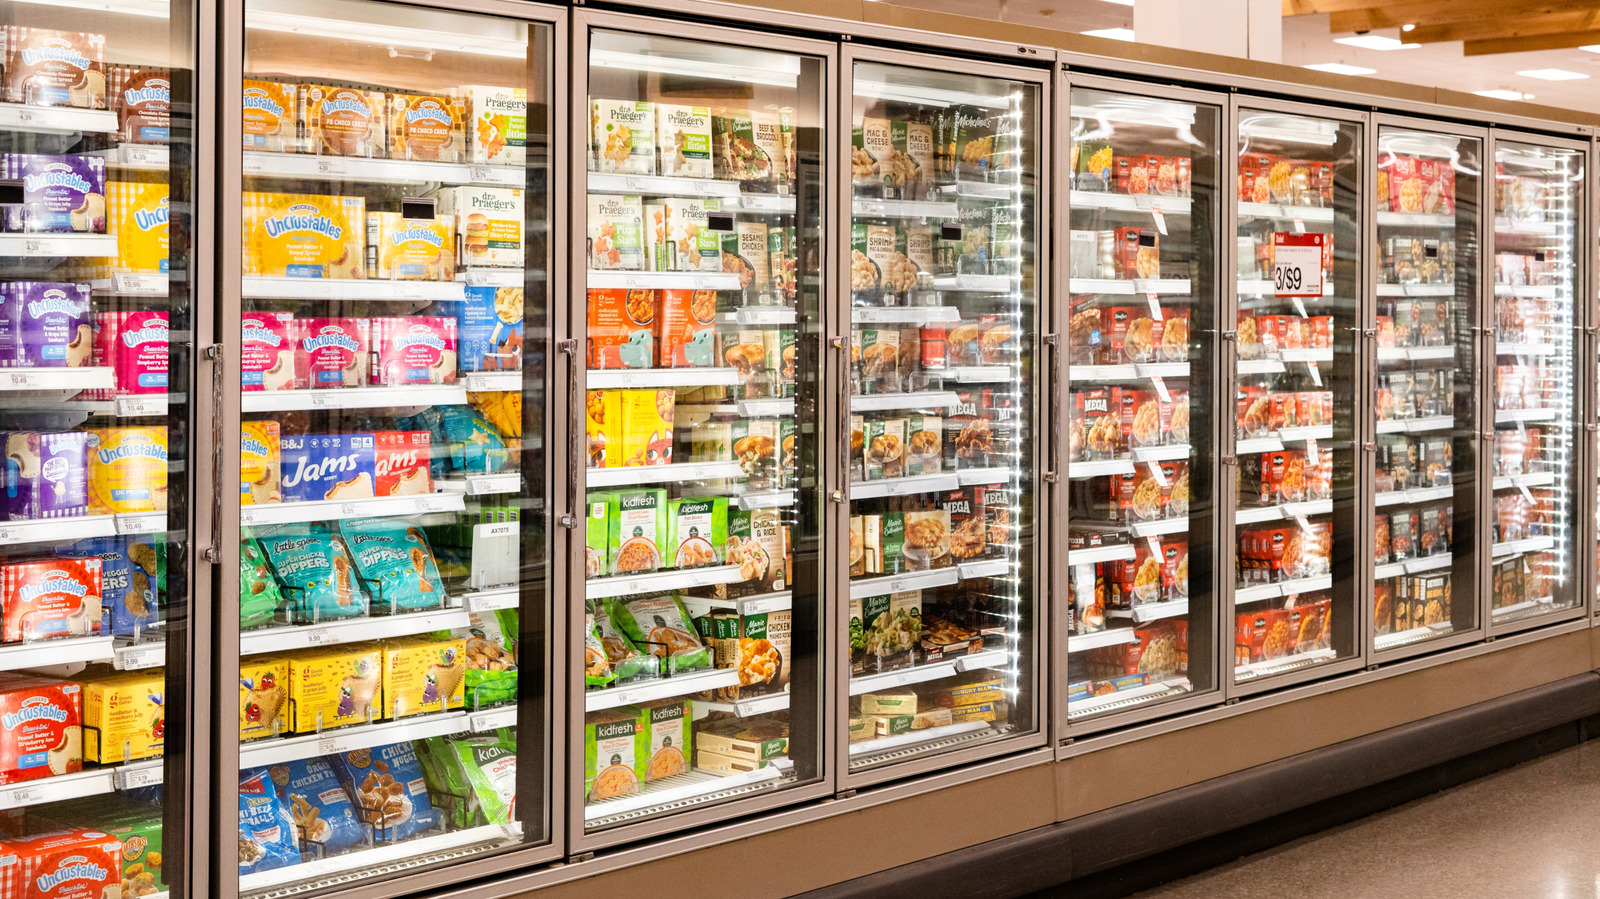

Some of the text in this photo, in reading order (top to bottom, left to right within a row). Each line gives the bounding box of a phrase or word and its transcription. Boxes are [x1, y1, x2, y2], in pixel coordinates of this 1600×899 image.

[22, 48, 90, 70] Uncrustables
[322, 100, 371, 118] Uncrustables
[486, 97, 526, 111] Praeger's
[406, 108, 452, 125] Uncrustables
[610, 110, 648, 122] Praeger's
[668, 114, 704, 128] Praeger's
[506, 129, 526, 138] littles
[759, 124, 770, 132] BEEF
[866, 128, 880, 138] MAC
[756, 132, 779, 142] BROCCOLI
[866, 136, 888, 146] CHEESE
[910, 134, 930, 144] MAC &
[688, 142, 706, 150] littles
[910, 142, 930, 151] CHEESE
[25, 172, 90, 194] Uncrustables
[472, 197, 516, 212] Praeger's
[598, 204, 636, 216] Praeger's
[264, 214, 342, 239] Uncrustables
[616, 224, 636, 234] Pizza
[392, 228, 442, 246] Uncrustables
[617, 235, 637, 245] Stars
[699, 238, 716, 248] Stars
[742, 234, 764, 242] SESAME
[869, 237, 893, 247] SHRIMP
[742, 242, 764, 250] CHICKEN
[909, 239, 930, 248] SHRIMP
[1276, 266, 1302, 292] 3/$9
[28, 298, 80, 319] Uncrustables
[304, 333, 359, 352] Uncrustables
[392, 332, 446, 350] Uncrustables
[1084, 399, 1108, 411] MEGA
[282, 454, 360, 488] Jams
[622, 496, 654, 508] kidfresh
[942, 500, 970, 514] MEGA
[682, 504, 708, 514] kidfresh
[756, 528, 776, 537] & RICE
[274, 538, 320, 554] little spoon
[277, 558, 298, 568] SUPER
[362, 550, 408, 568] DIPPERS
[280, 558, 330, 577] DIPPERS
[20, 578, 87, 602] Uncrustables
[868, 596, 888, 608] Marie
[768, 623, 790, 632] CHICKEN
[926, 652, 943, 661] MEGA
[2, 704, 67, 730] Uncrustables
[652, 706, 682, 721] kidfresh
[598, 722, 633, 738] kidfresh
[292, 773, 324, 789] CHICKEN
[38, 864, 107, 891] Uncrustables
